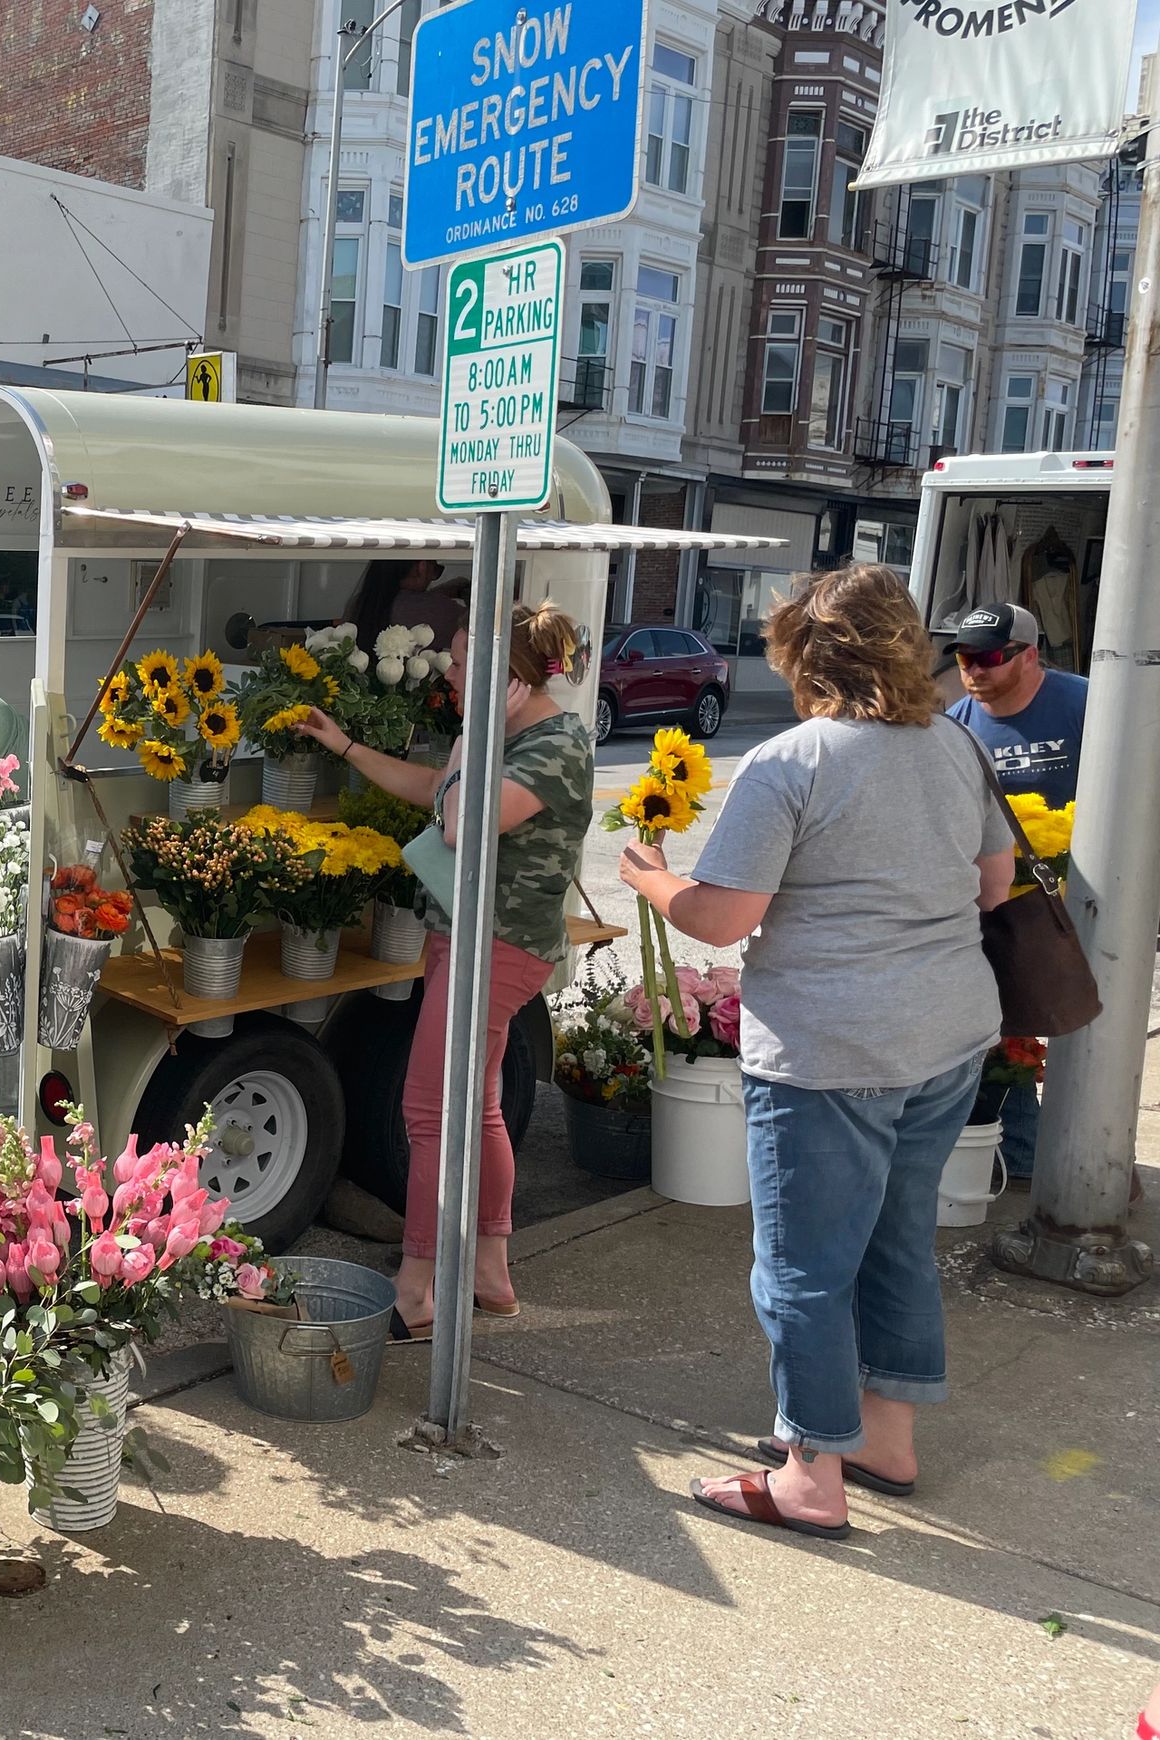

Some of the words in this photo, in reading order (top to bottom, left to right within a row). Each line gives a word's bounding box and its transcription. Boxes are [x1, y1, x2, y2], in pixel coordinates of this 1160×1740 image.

[900, 0, 1077, 39] ROMEN
[471, 3, 572, 86] SNOW
[414, 45, 634, 166] EMERGENCY
[962, 106, 1002, 127] the
[957, 114, 1062, 150] District
[455, 132, 572, 211] ROUTE
[446, 209, 517, 244] ORDINANCE
[525, 203, 546, 224] NO.
[551, 194, 579, 217] 628
[508, 260, 537, 296] HR
[453, 278, 479, 340] 2
[484, 297, 553, 340] PARKING
[454, 402, 470, 433] TO
[450, 438, 500, 464] MONDAY
[509, 433, 542, 458] THRU
[471, 469, 515, 495] FRIDAY
[993, 738, 1065, 759] KLEY
